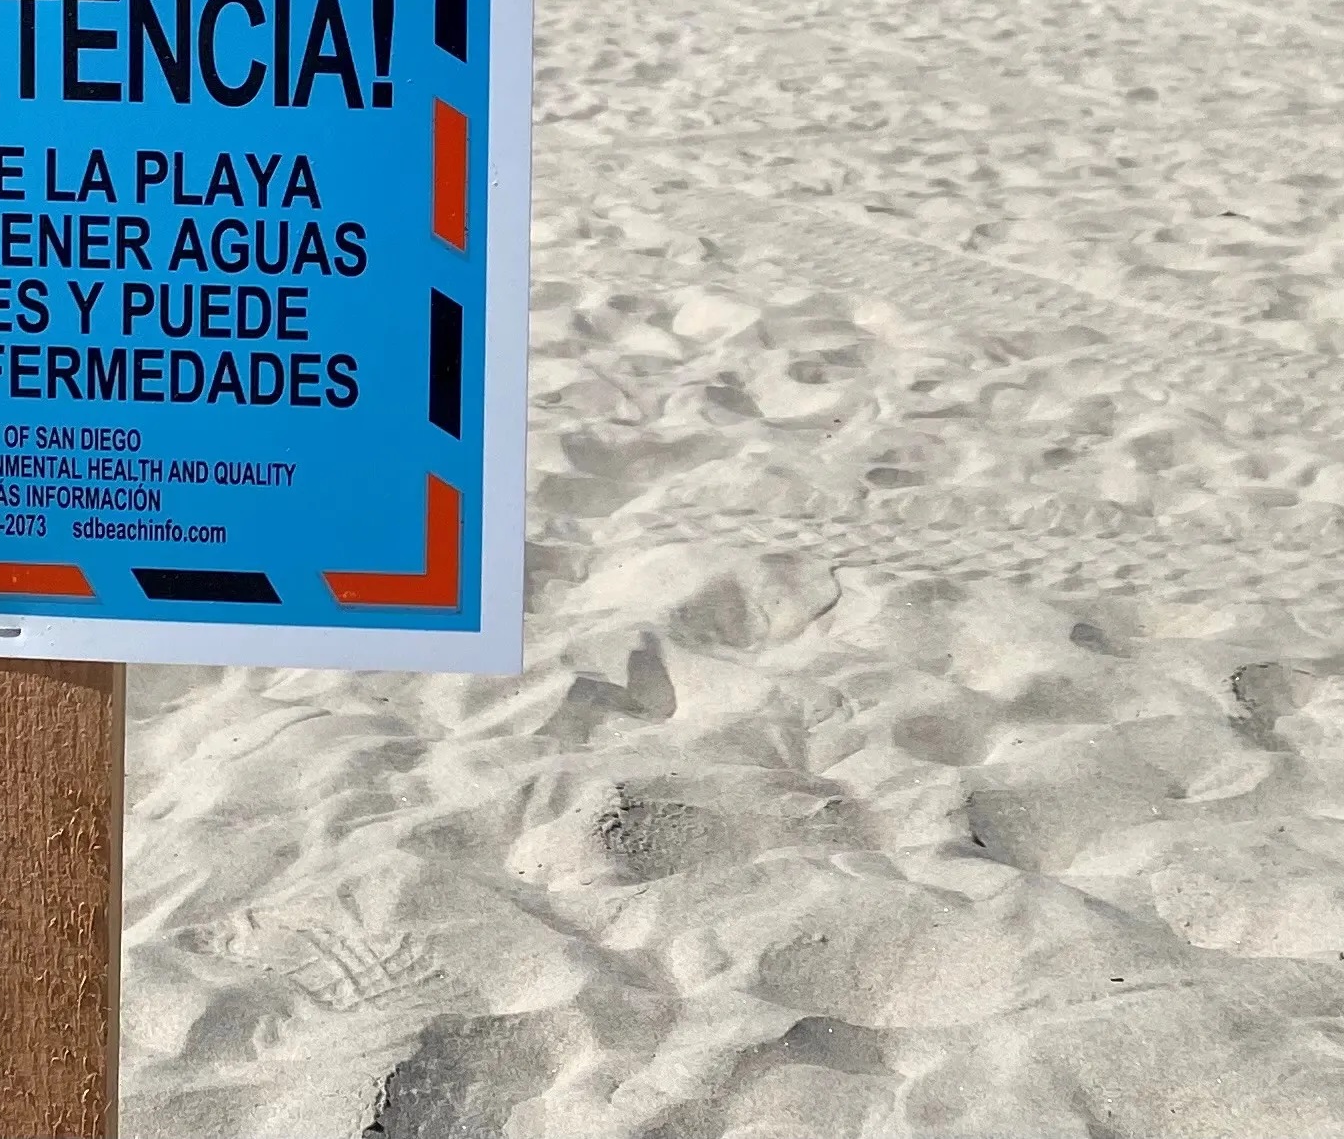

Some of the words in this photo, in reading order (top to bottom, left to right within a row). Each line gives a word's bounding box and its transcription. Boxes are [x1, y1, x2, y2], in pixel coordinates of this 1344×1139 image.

[46, 148, 117, 203] LA
[136, 150, 322, 210] PLAYA
[168, 218, 367, 277] AGUAS
[67, 280, 104, 335] Y
[122, 282, 309, 341] PUEDE
[4, 424, 30, 449] OF
[35, 426, 75, 450] SAN
[80, 427, 142, 452] DIEGO
[87, 457, 163, 483] HEALTH
[167, 459, 209, 484] AND
[213, 461, 297, 487] QUALITY
[26, 482, 161, 512] INFORMACIÓN
[72, 516, 227, 544] sdbeachinfo.com
